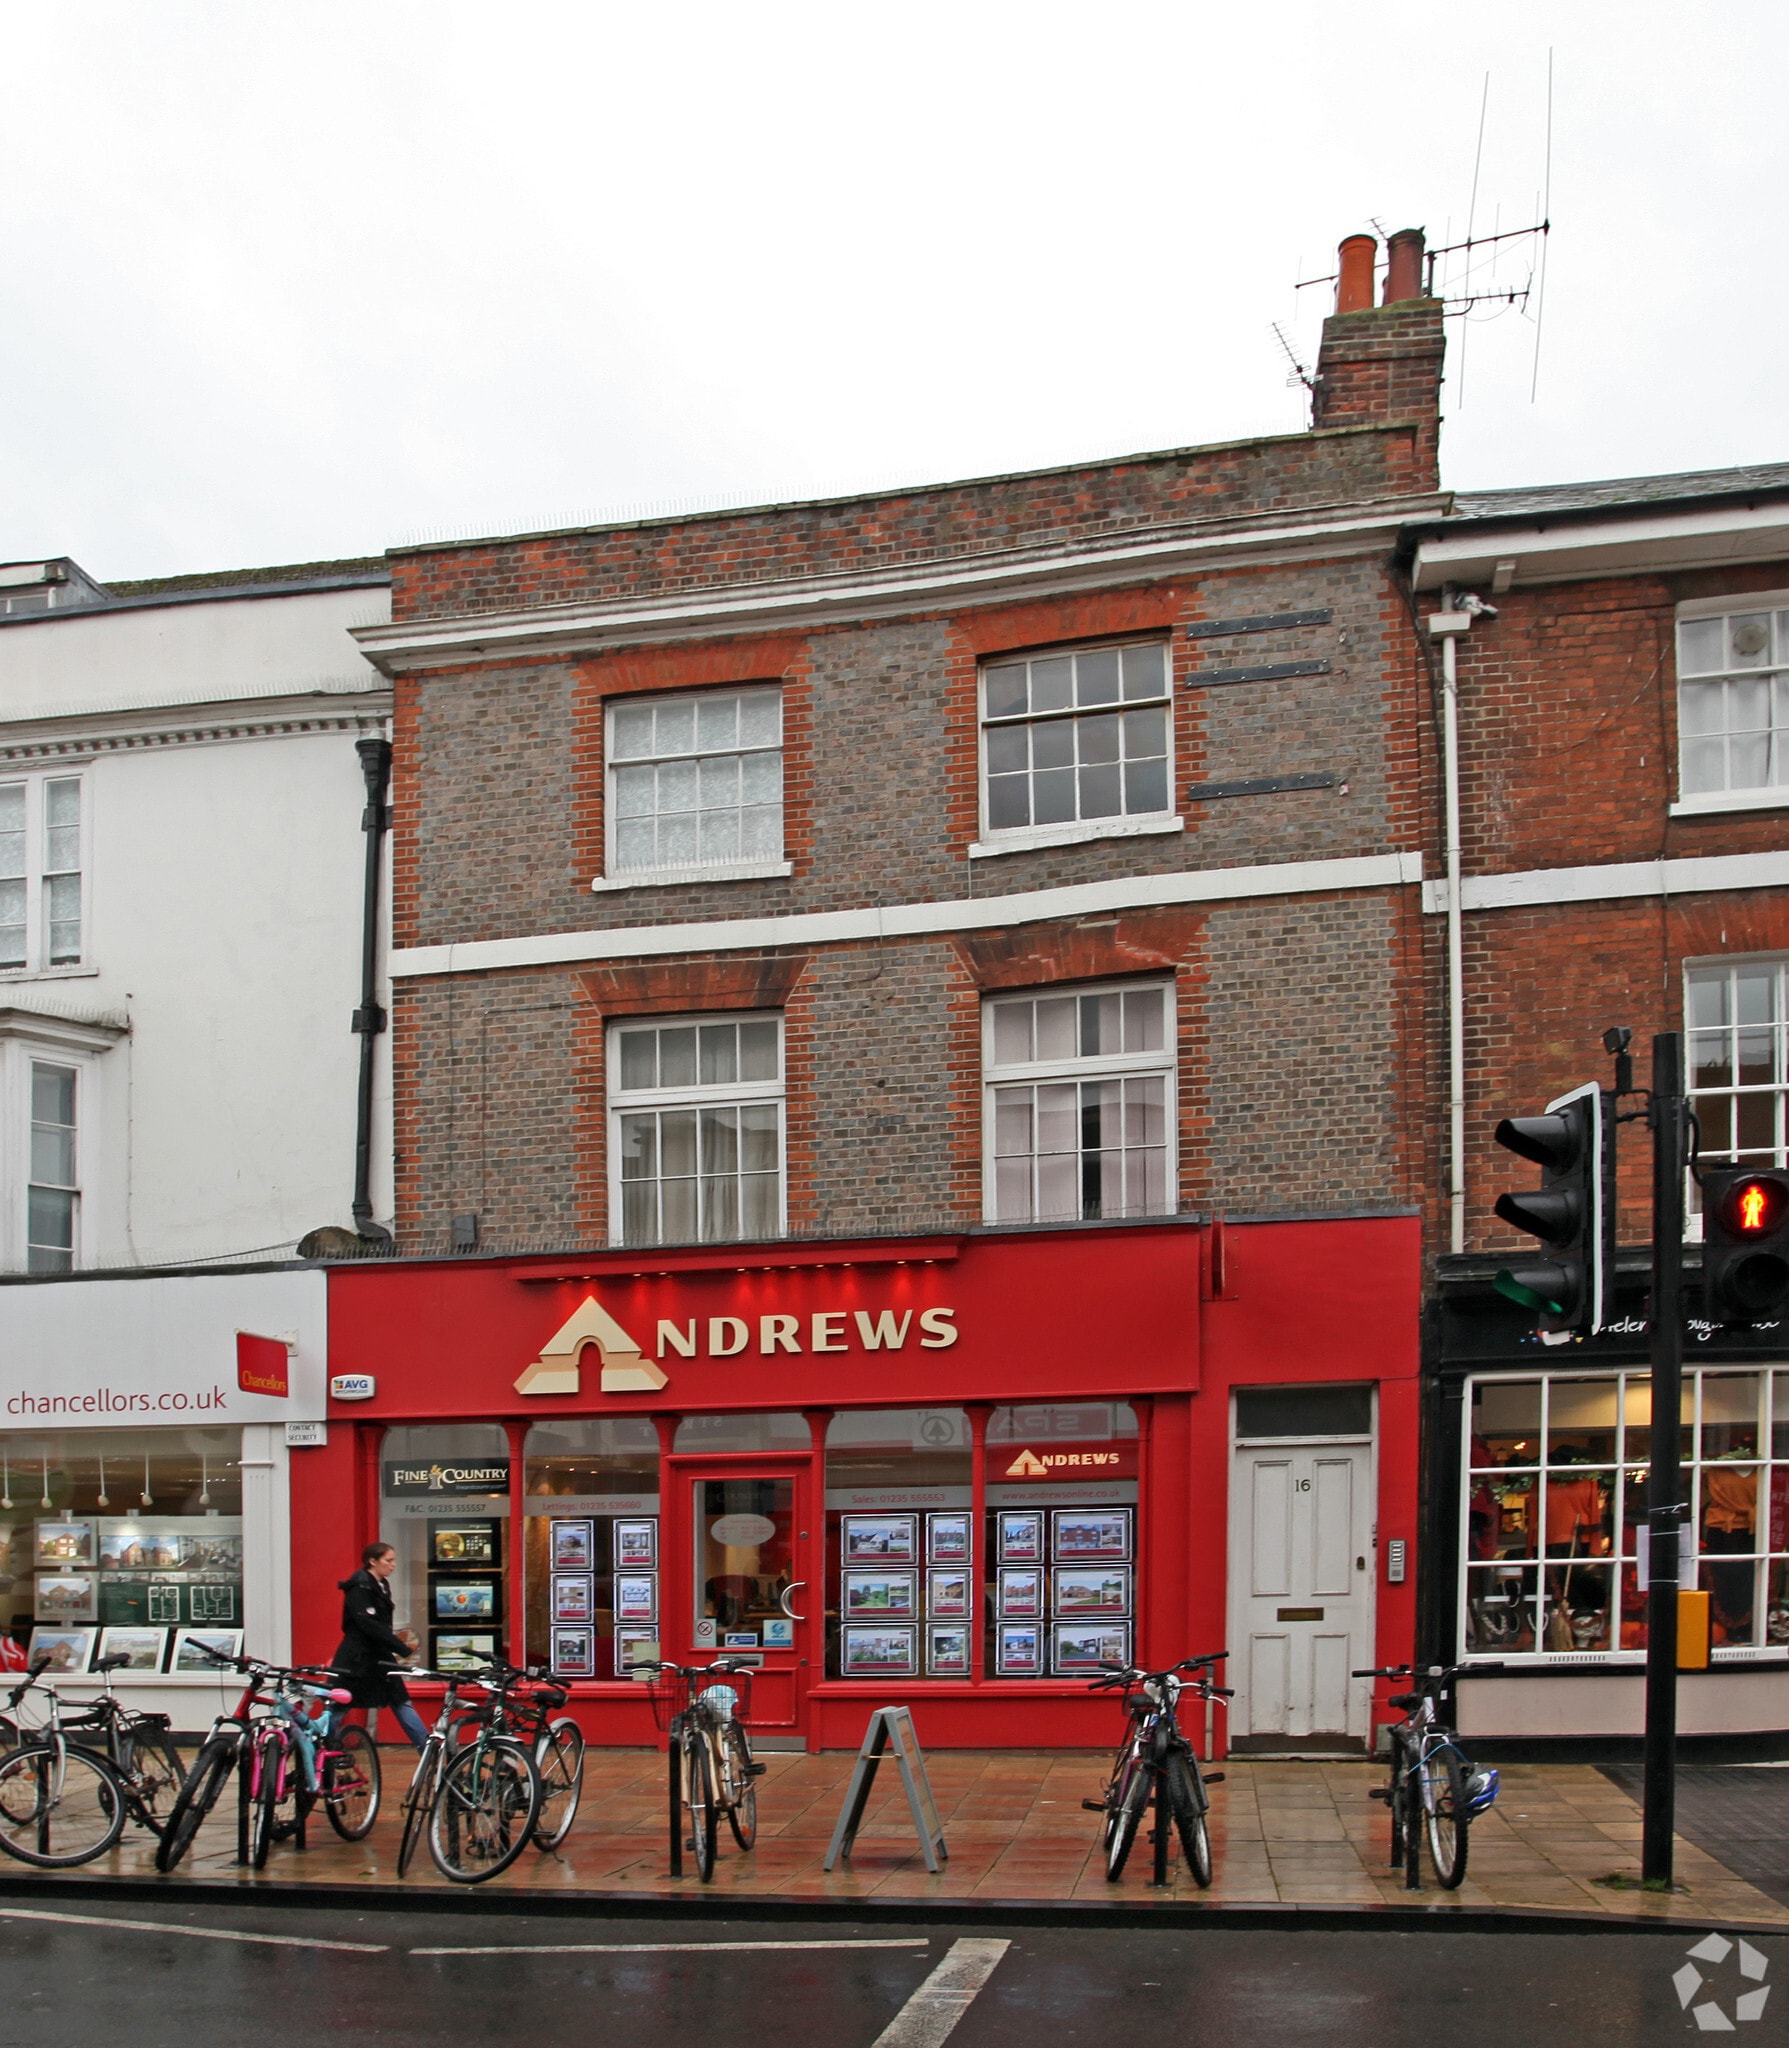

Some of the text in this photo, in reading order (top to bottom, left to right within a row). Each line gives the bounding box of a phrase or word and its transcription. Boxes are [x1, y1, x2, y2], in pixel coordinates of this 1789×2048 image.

[513, 1295, 958, 1395] ANDREWS
[242, 1369, 287, 1392] Chancellors
[344, 1380, 369, 1389] AVG
[7, 1385, 228, 1415] chancellors.co.uk
[1005, 1449, 1120, 1476] ANDREWS
[393, 1469, 428, 1486] FINE
[442, 1468, 508, 1484] COUNTRY
[1295, 1479, 1311, 1492] 16
[852, 1494, 878, 1504] Sales:
[880, 1494, 908, 1504] 01235
[1002, 1488, 1121, 1500] www.andrewsonline.co.uk
[542, 1502, 576, 1513] Lettings:
